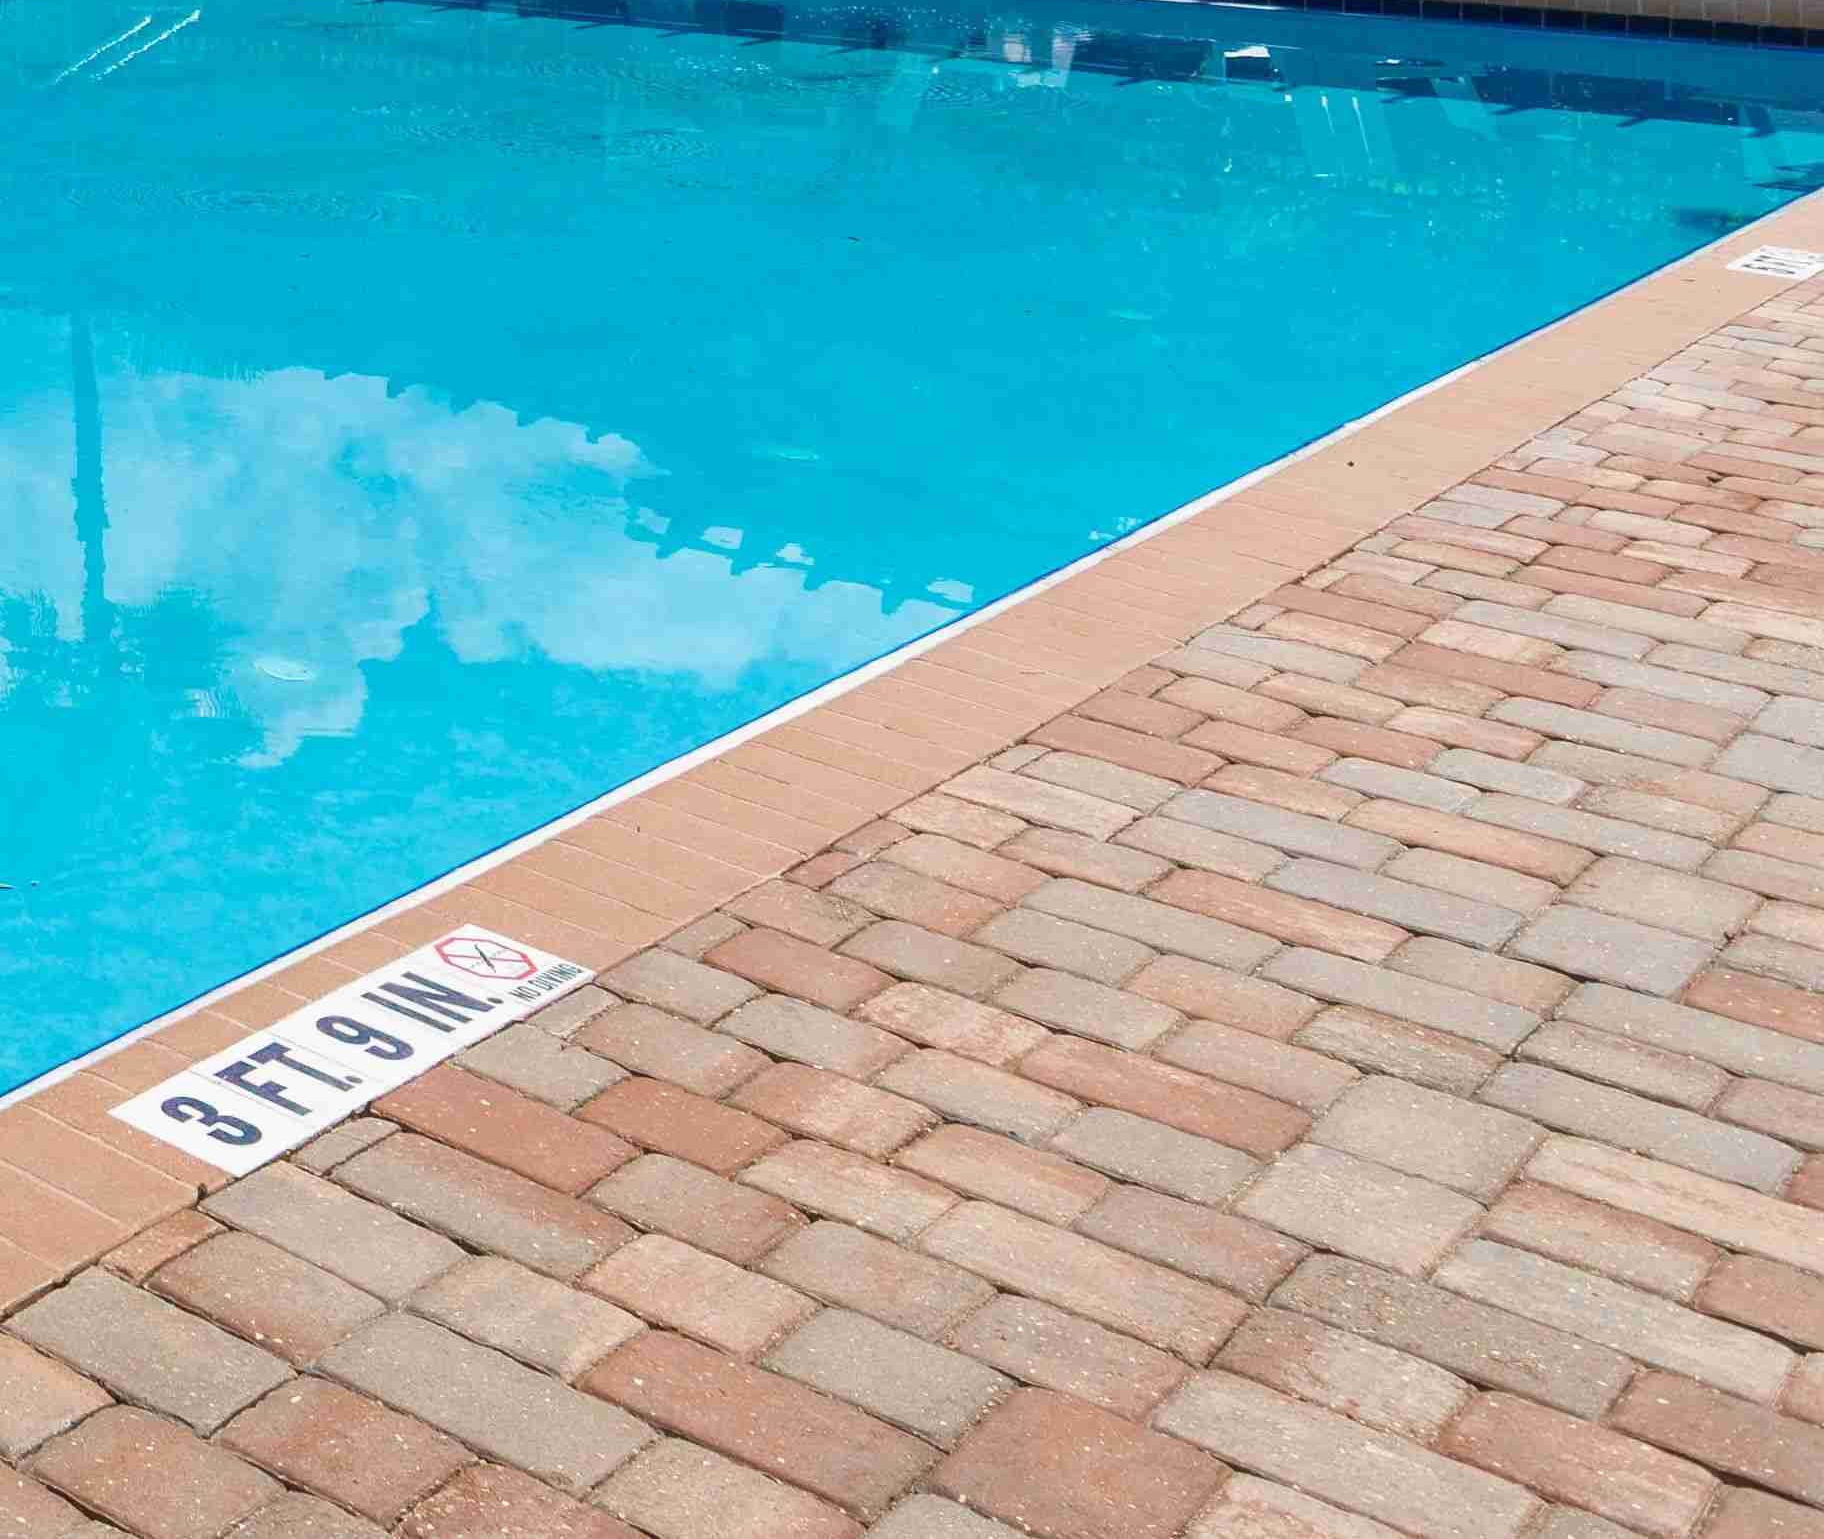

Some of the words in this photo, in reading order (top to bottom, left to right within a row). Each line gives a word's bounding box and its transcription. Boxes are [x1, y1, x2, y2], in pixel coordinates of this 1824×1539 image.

[360, 971, 504, 1033] IN.
[508, 986, 542, 1002] NO
[316, 1014, 414, 1061] 9
[213, 1041, 364, 1117] FT.
[160, 1095, 262, 1146] 3
